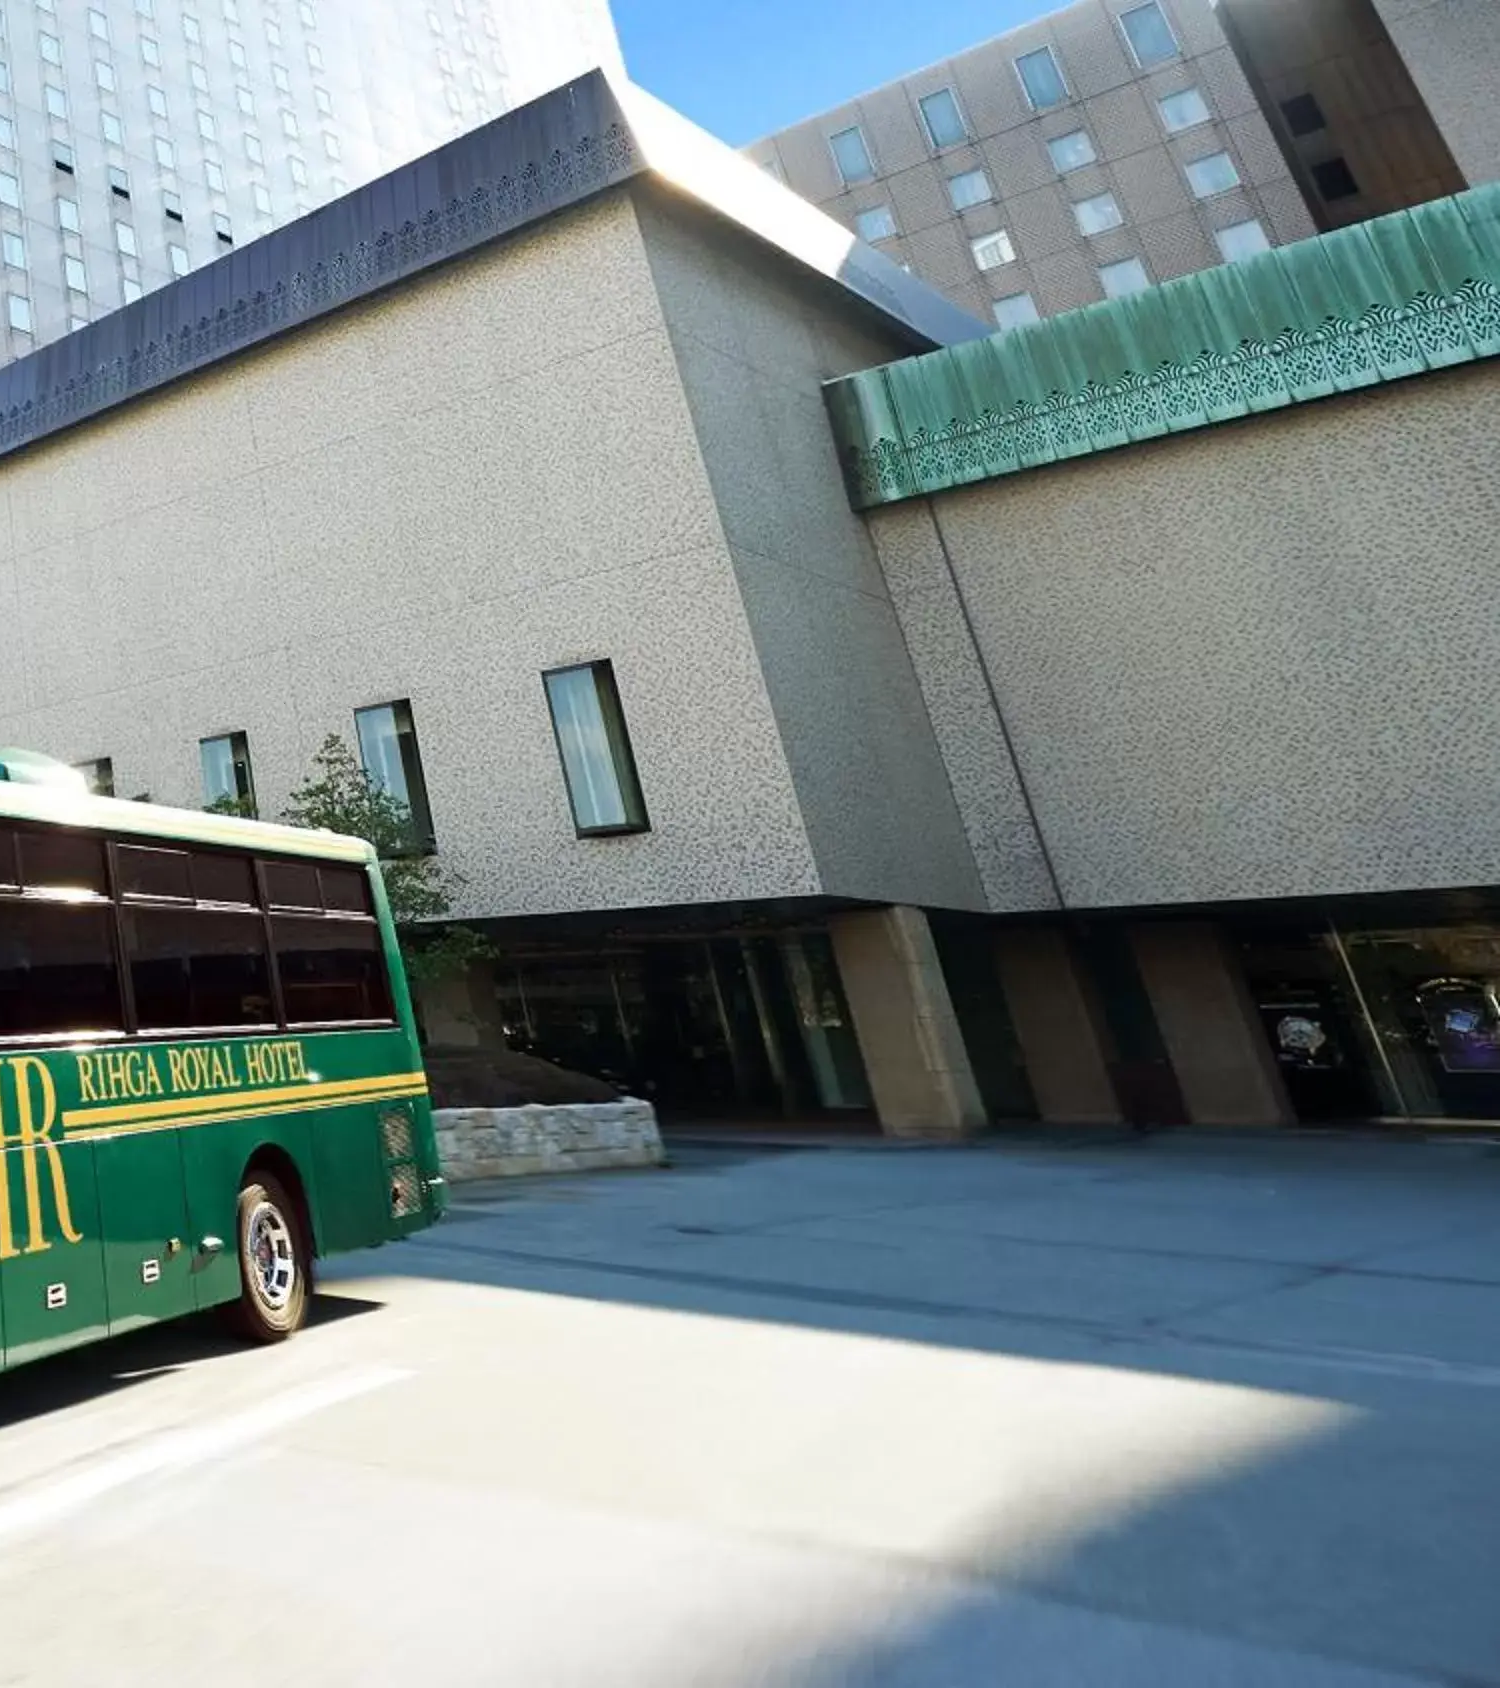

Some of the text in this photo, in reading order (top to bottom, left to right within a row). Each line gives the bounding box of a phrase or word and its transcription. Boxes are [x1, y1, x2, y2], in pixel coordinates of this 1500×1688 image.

[76, 1041, 311, 1102] RIHGA ROYAL HOTEL
